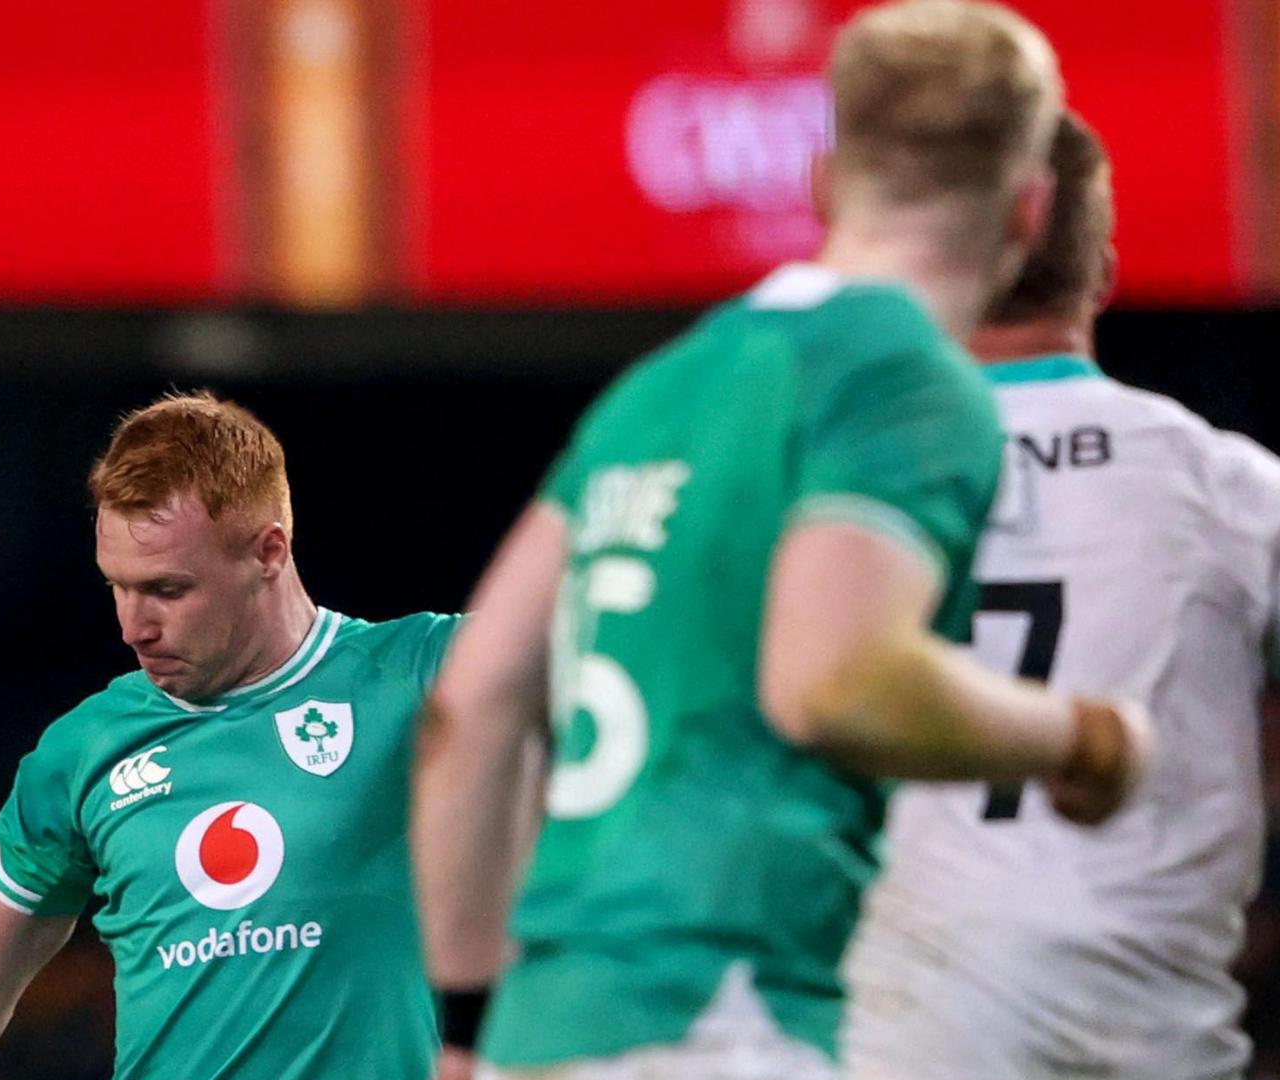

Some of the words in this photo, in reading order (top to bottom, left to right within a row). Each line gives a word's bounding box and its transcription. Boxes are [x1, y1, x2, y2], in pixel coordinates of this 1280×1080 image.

[1008, 426, 1113, 472] NB
[306, 750, 339, 767] IRFU
[110, 781, 172, 811] canterbury
[156, 919, 323, 970] vodafone
